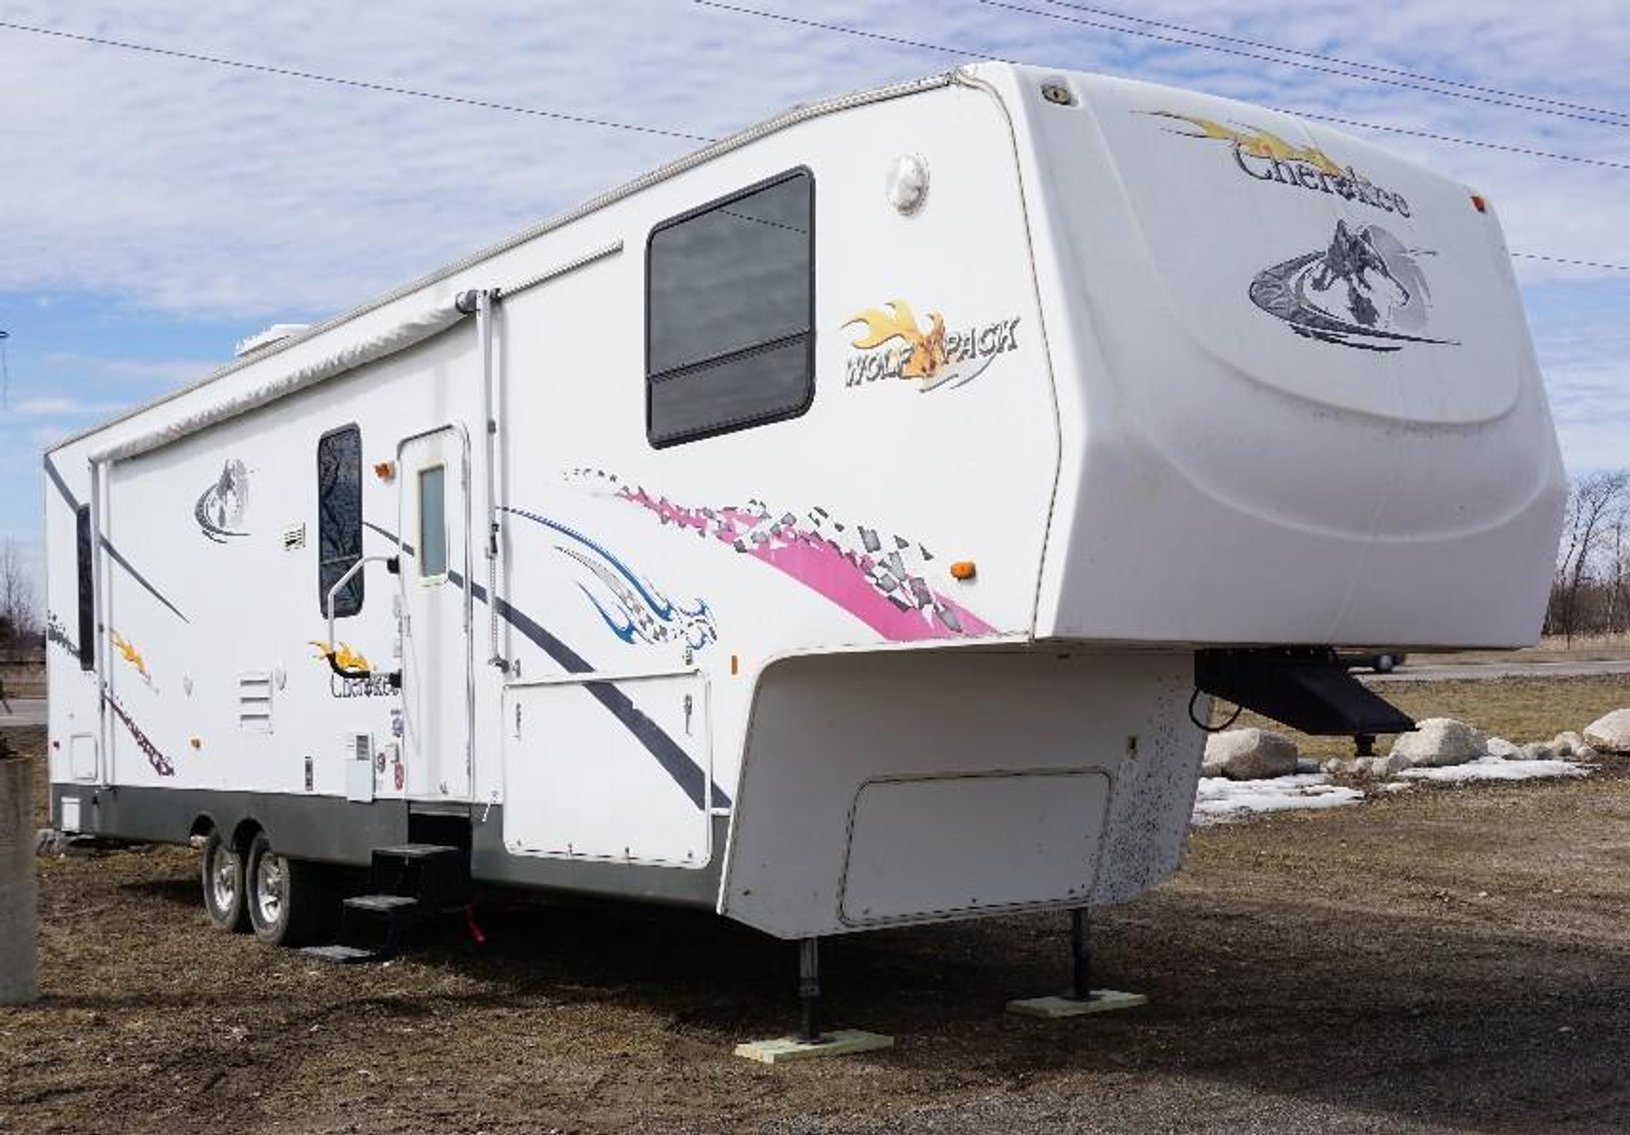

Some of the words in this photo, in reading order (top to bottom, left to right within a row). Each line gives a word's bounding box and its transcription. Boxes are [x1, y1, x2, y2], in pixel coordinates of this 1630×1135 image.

[1233, 143, 1411, 218] Cherokee
[845, 345, 914, 388] WOLF
[942, 316, 1021, 365] PACK
